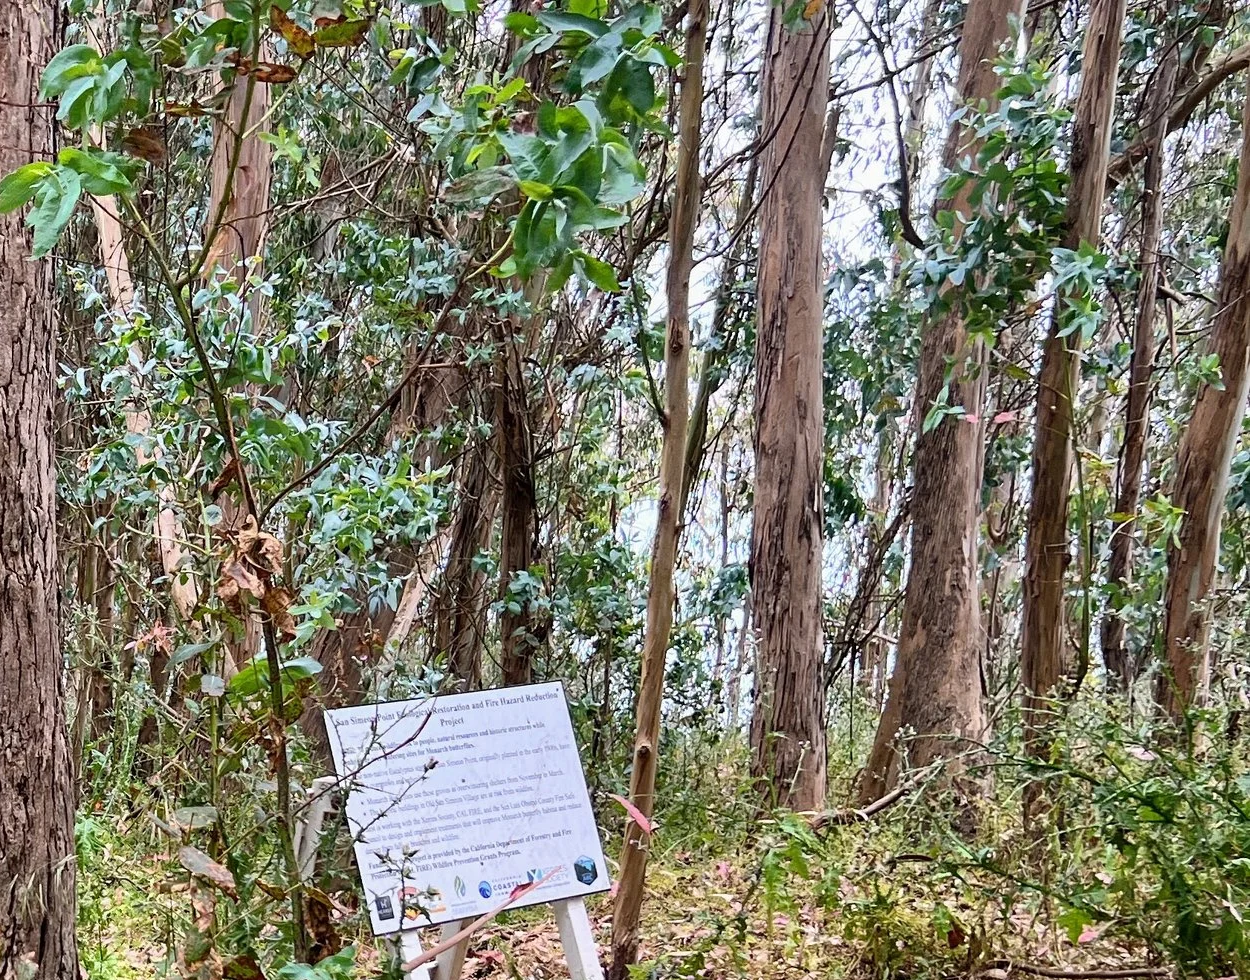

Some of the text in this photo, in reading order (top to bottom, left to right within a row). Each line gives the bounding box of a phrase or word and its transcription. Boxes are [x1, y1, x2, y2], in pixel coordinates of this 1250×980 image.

[336, 718, 349, 726] San
[377, 712, 395, 720] Point
[432, 703, 470, 713] Restoration
[500, 696, 524, 705] Hazard
[526, 692, 558, 701] Reduction
[440, 717, 464, 728] Project
[470, 843, 495, 851] California
